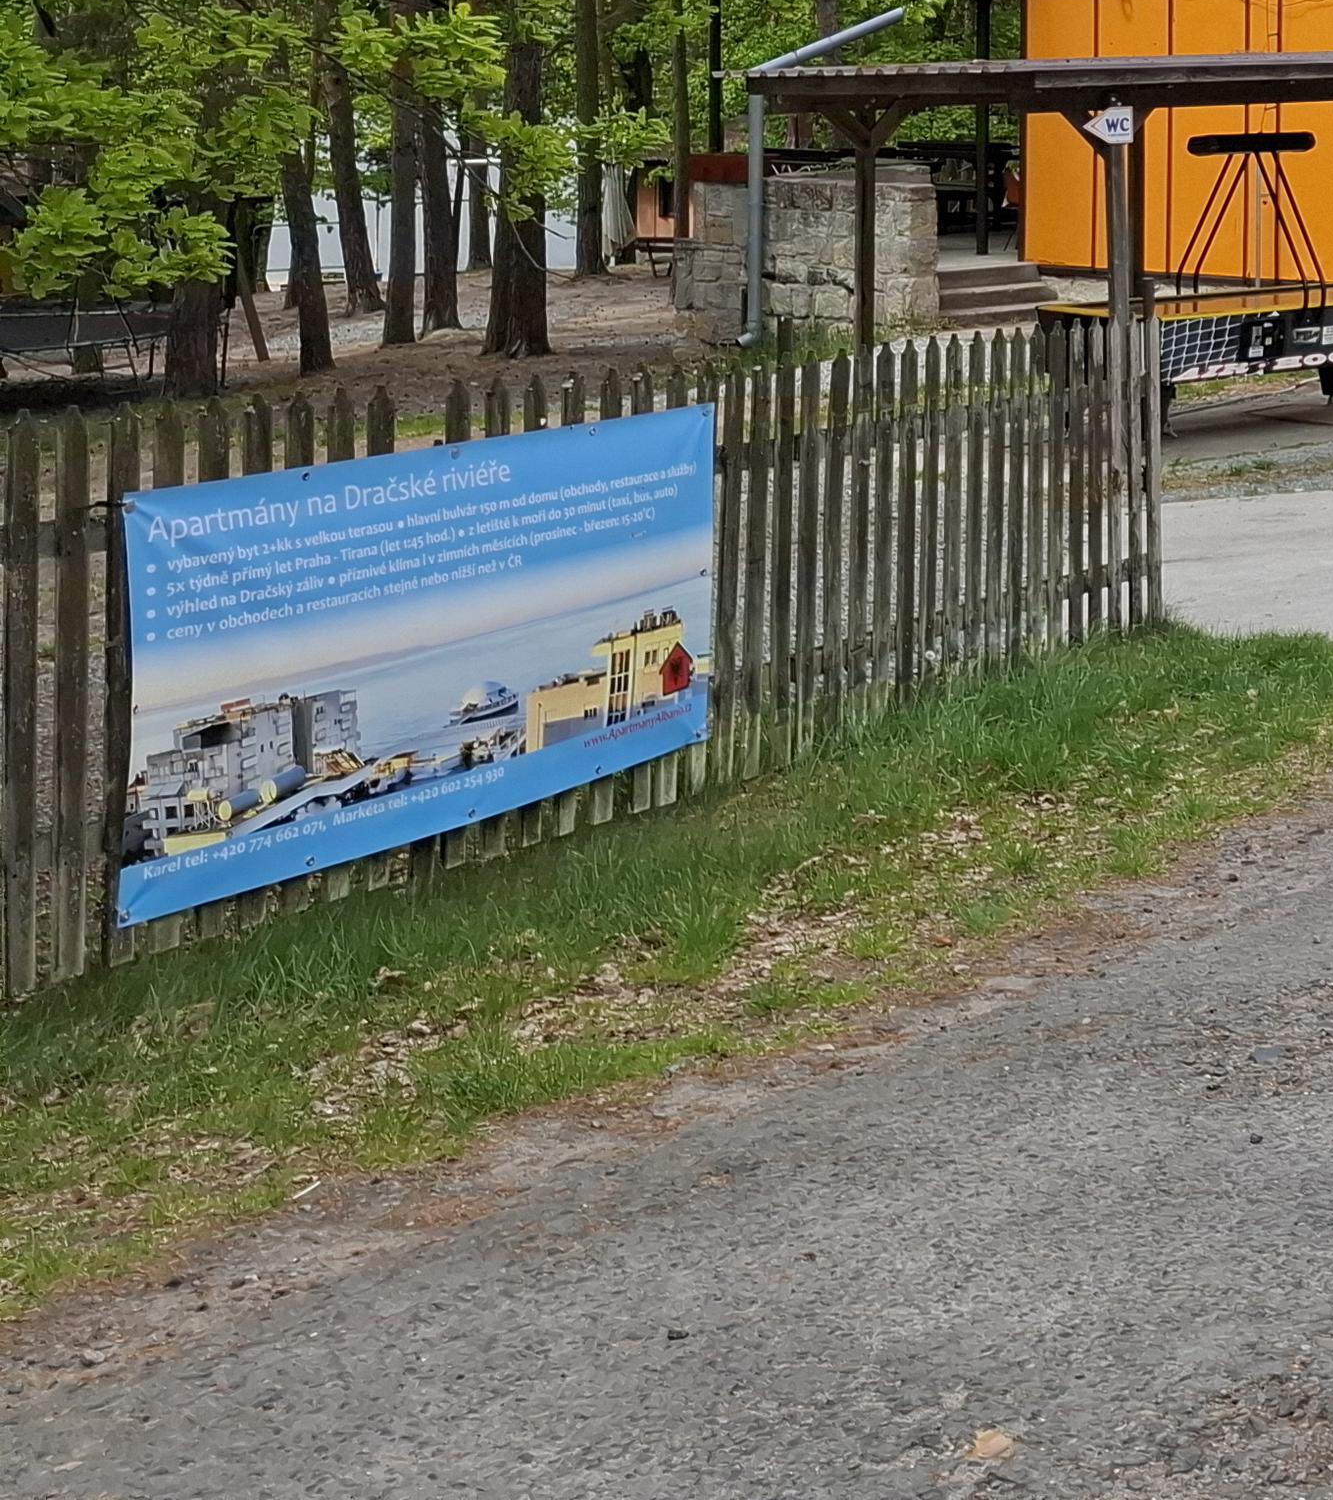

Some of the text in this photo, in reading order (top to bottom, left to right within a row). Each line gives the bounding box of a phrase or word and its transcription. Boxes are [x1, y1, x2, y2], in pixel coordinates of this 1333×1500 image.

[1105, 117, 1130, 133] WC
[146, 459, 511, 548] Apartmány na Dračské riviéře
[166, 581, 185, 597] 5x
[189, 569, 229, 593] týdně
[232, 561, 273, 586] přímý
[273, 559, 294, 574] let
[294, 552, 332, 570] Praha
[340, 545, 378, 561] Tirana
[379, 539, 401, 556] (let
[425, 526, 455, 545] hod.)
[476, 516, 512, 534] letiště
[548, 507, 562, 521] do
[563, 505, 576, 520] 30
[577, 499, 607, 515] minut
[654, 483, 678, 500] auto)
[167, 546, 236, 573] vybavený
[236, 544, 261, 561] byt
[261, 536, 293, 554] 2+kk
[296, 538, 302, 548] s
[303, 529, 347, 547] velkou
[348, 520, 394, 539] terasou
[406, 508, 441, 528] hlavní
[441, 502, 478, 521] bulvár
[479, 500, 498, 515] 150
[499, 500, 510, 510] m
[512, 493, 526, 508] od
[527, 489, 559, 505] domu
[560, 479, 610, 501] (obchody,
[610, 471, 659, 490] restaurace
[166, 593, 219, 619] výhled
[219, 594, 237, 607] na
[239, 580, 294, 603] Dračský
[296, 574, 325, 592] záliv
[339, 561, 388, 587] příznivé
[429, 555, 435, 564] v
[437, 542, 480, 563] zimních
[480, 533, 528, 554] měsících
[529, 525, 577, 547] (prosinec
[167, 623, 203, 639] ceny
[206, 620, 215, 632] v
[219, 602, 293, 629] obchodech
[307, 584, 381, 611] restauracích
[384, 575, 418, 595] stejné
[421, 571, 449, 587] nebo
[452, 563, 475, 580] nižší
[478, 559, 496, 574] než
[498, 560, 505, 569] v
[508, 553, 522, 568] ČR
[144, 859, 180, 879] Karel
[185, 851, 207, 867] tel:
[212, 843, 245, 860] +420
[250, 834, 272, 852] 774
[276, 827, 299, 842] 662
[333, 802, 385, 826] Markéta
[389, 793, 407, 809] tel:
[411, 786, 438, 803] +420
[441, 779, 461, 795] 602
[463, 773, 483, 789] 254
[485, 766, 504, 784] 930
